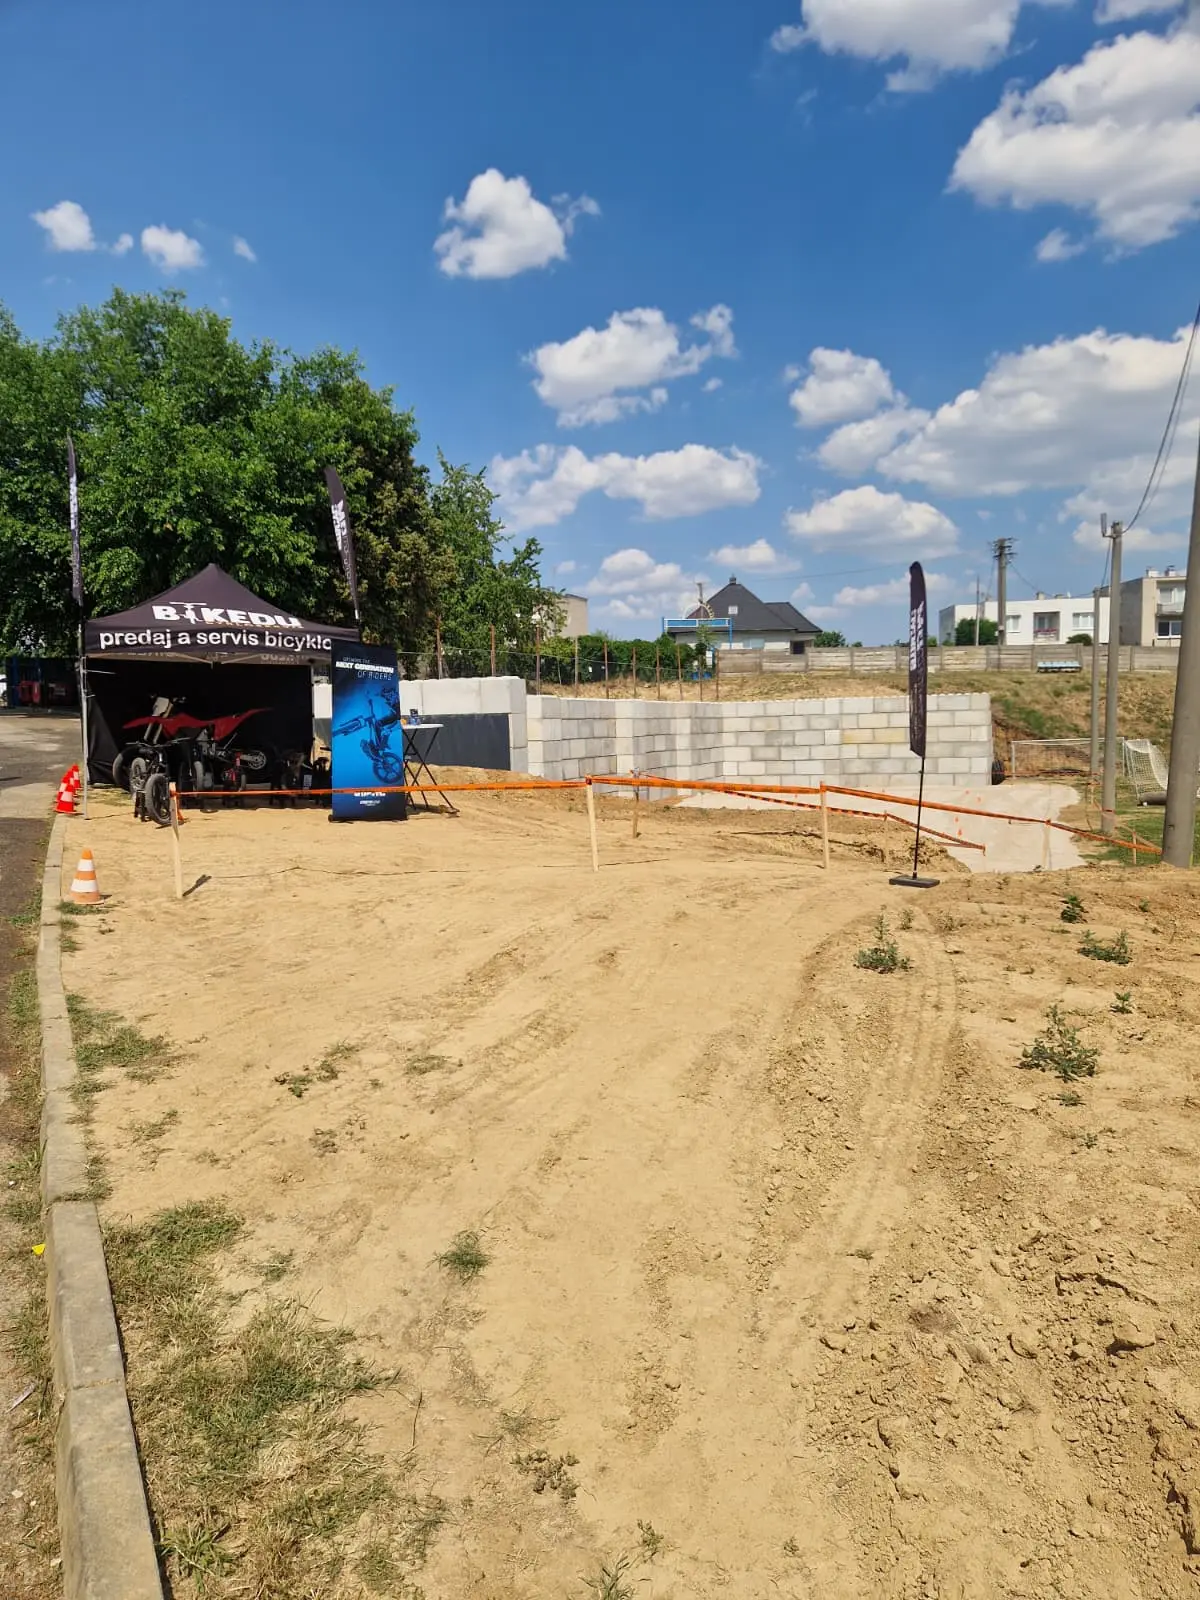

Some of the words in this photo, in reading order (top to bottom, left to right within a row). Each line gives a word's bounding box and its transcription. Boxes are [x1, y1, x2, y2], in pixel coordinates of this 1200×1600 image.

[100, 629, 171, 649] predaj
[177, 631, 191, 644] a
[196, 630, 259, 646] servis
